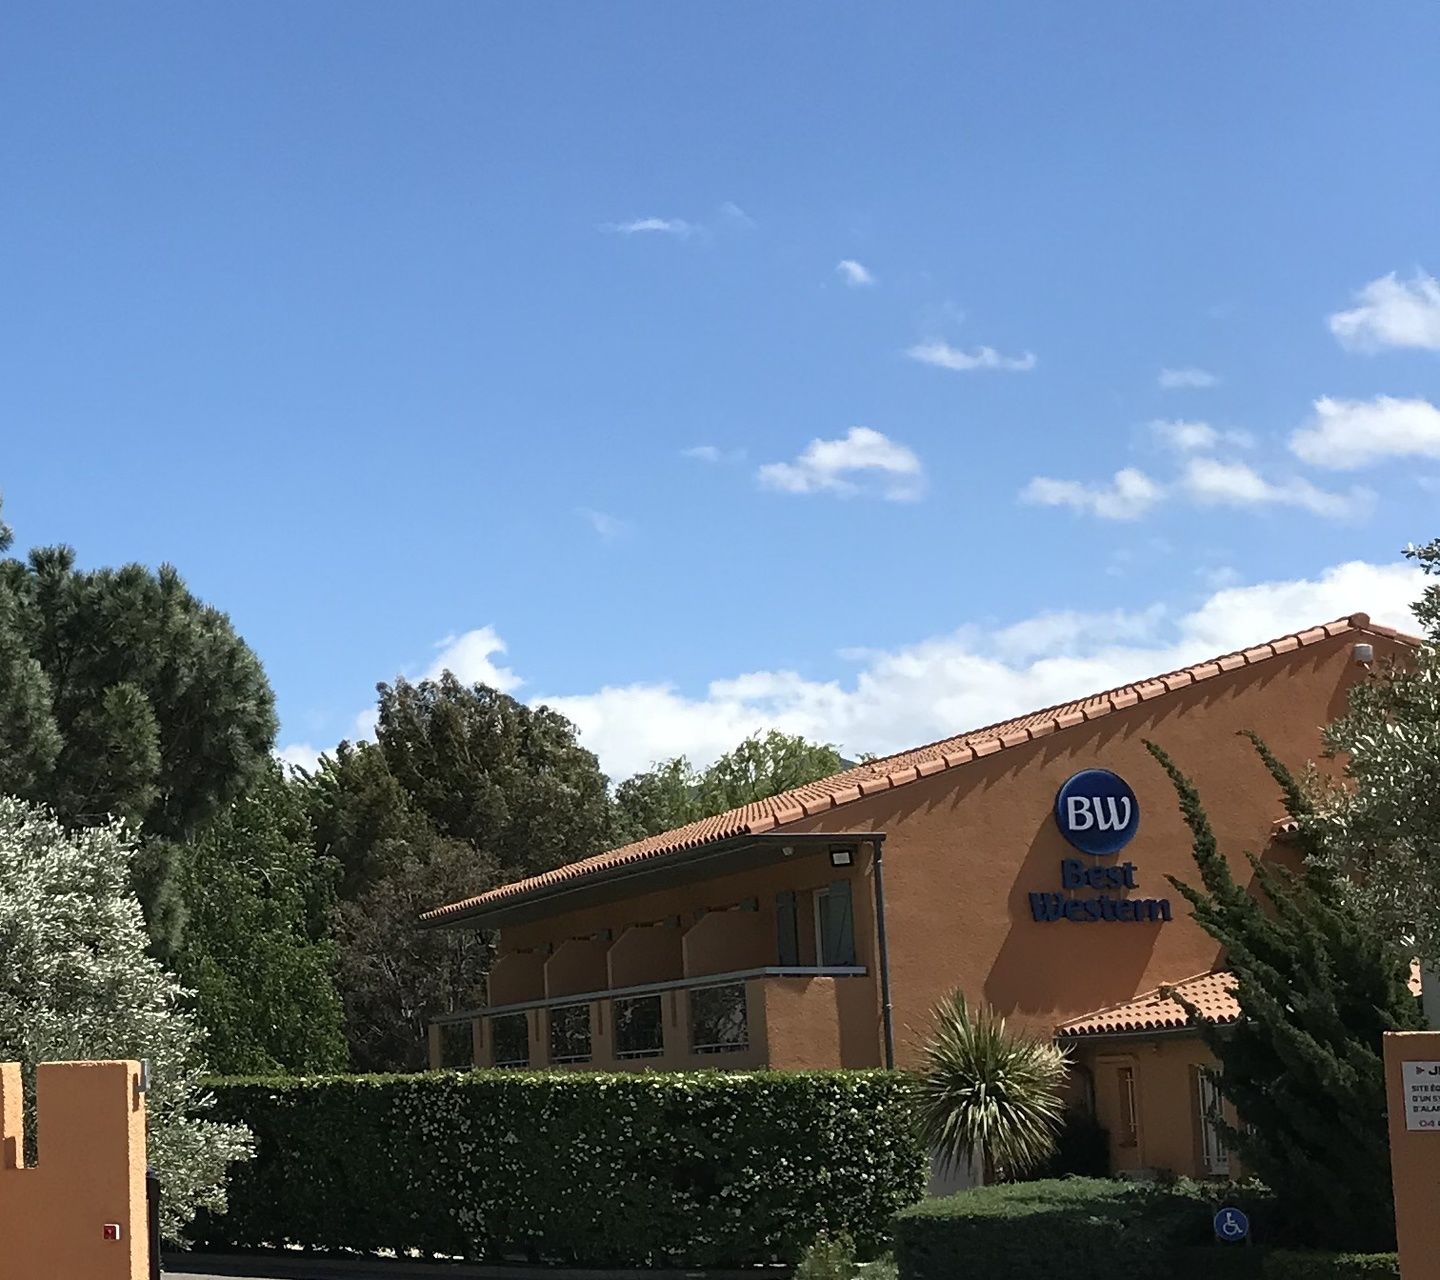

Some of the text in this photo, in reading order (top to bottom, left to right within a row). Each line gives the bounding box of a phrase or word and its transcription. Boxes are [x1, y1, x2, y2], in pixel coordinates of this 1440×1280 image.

[1066, 795, 1132, 832] BW
[1061, 858, 1140, 890] Best
[1028, 891, 1174, 923] Western
